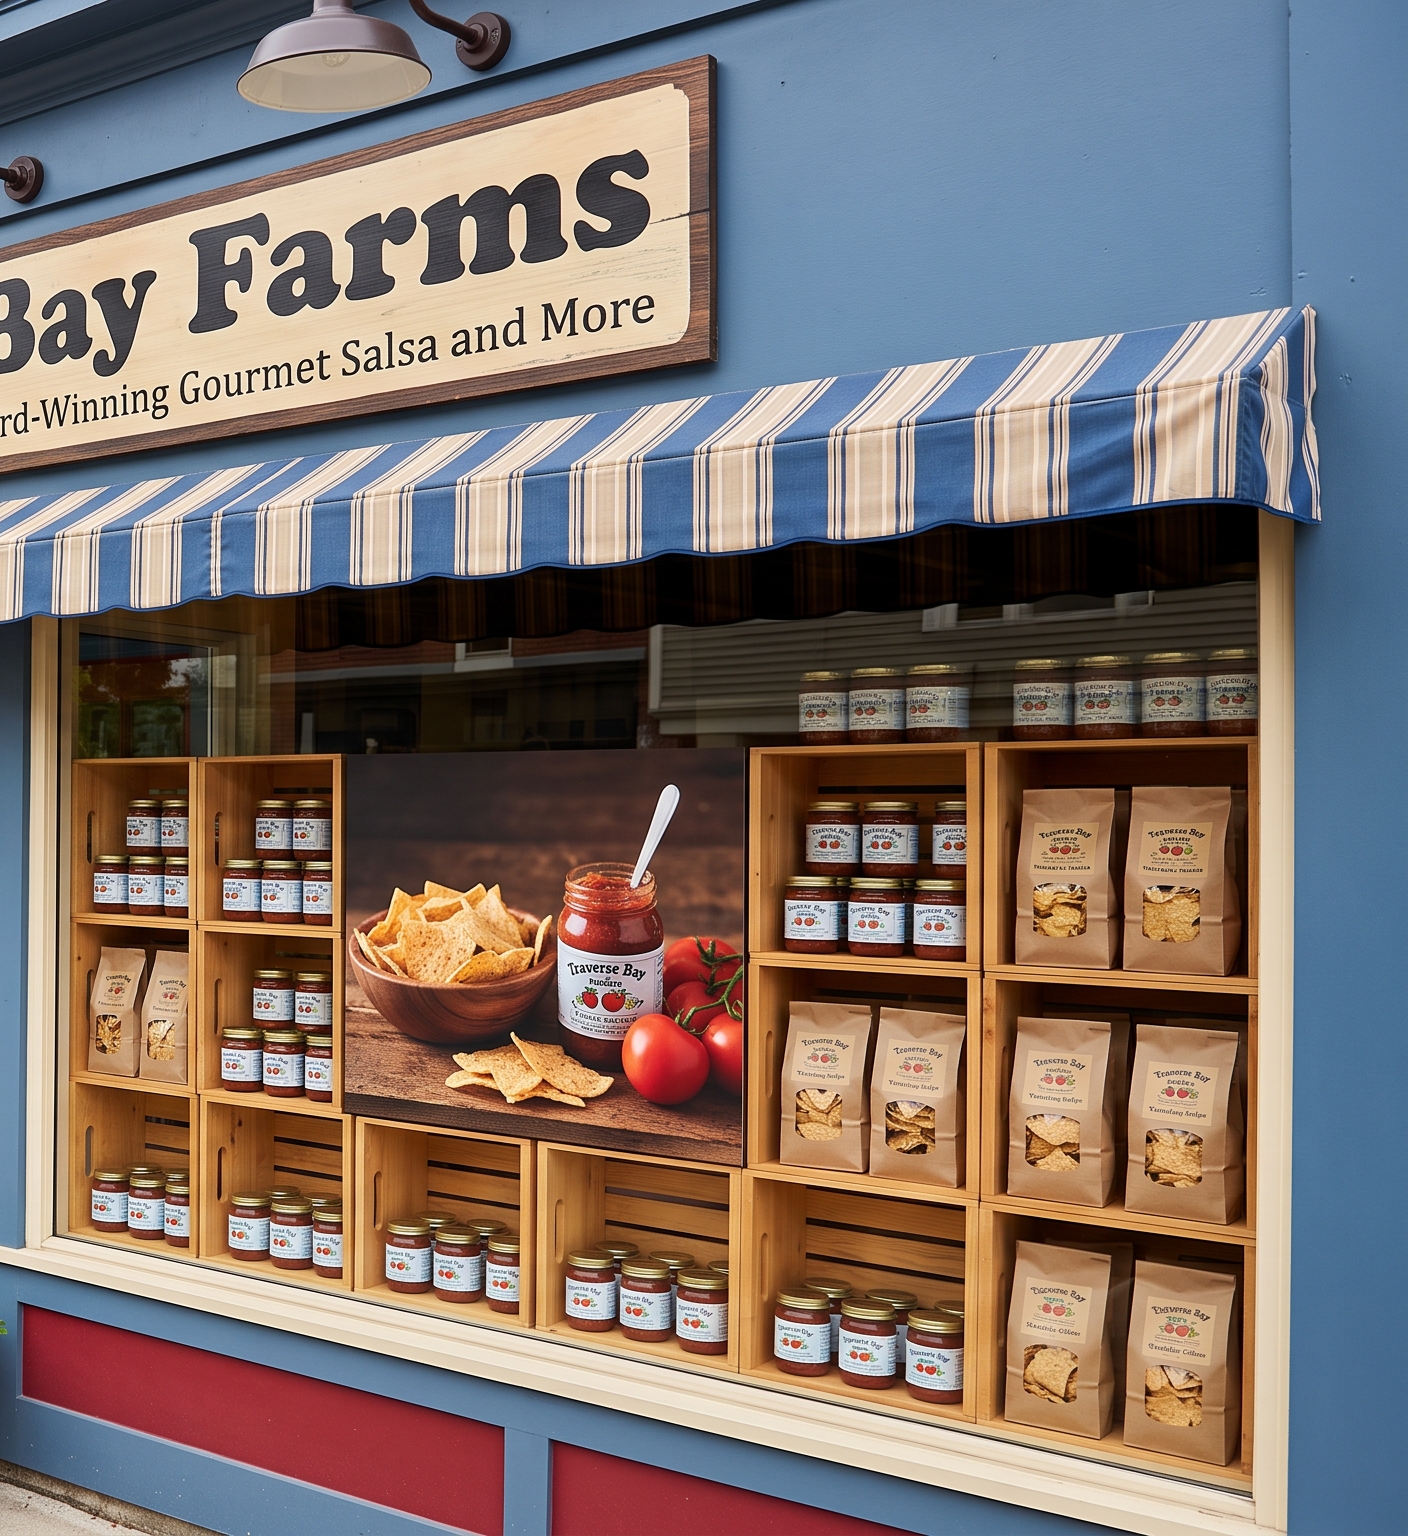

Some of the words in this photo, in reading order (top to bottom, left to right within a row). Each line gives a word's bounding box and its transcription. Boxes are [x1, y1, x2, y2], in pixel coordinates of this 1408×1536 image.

[187, 148, 652, 334] Farms
[179, 349, 331, 404] Gourmet
[340, 331, 437, 377] Salsa
[450, 306, 528, 357] and
[540, 293, 656, 342] More
[567, 962, 620, 976] Traverse
[621, 963, 647, 982] Bay
